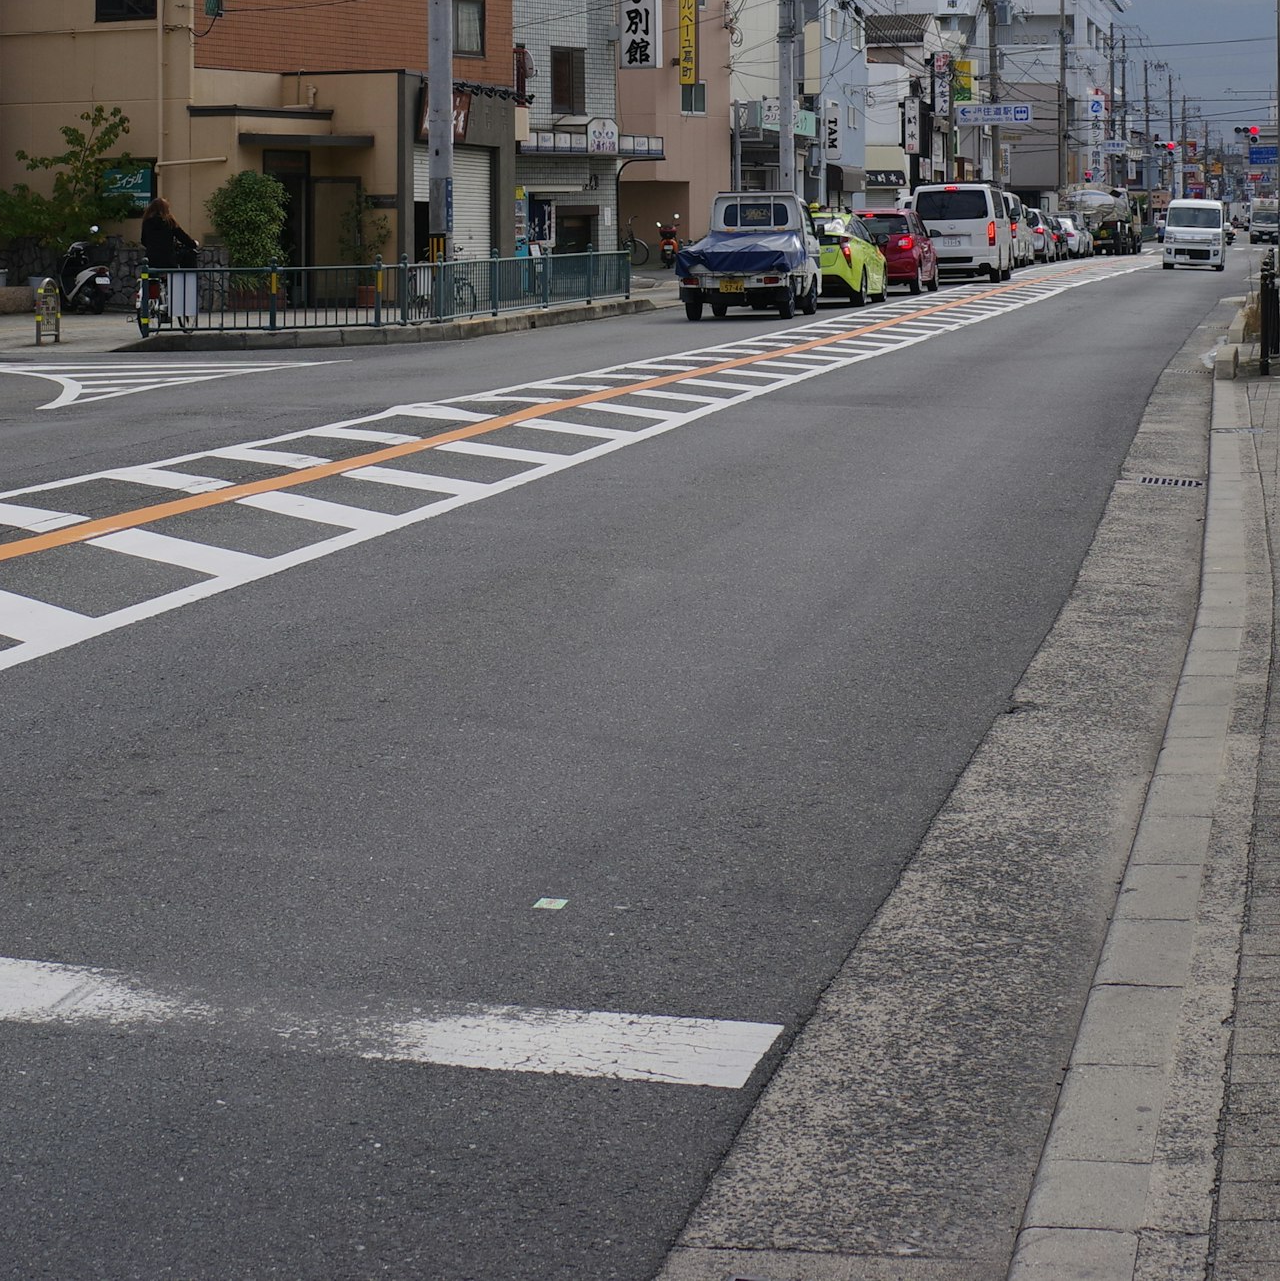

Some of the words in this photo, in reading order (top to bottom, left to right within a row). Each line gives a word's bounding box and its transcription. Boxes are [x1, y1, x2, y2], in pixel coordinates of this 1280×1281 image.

[937, 73, 948, 114] んちゃん
[973, 106, 1013, 116] JR住道駅
[828, 118, 838, 149] TAM
